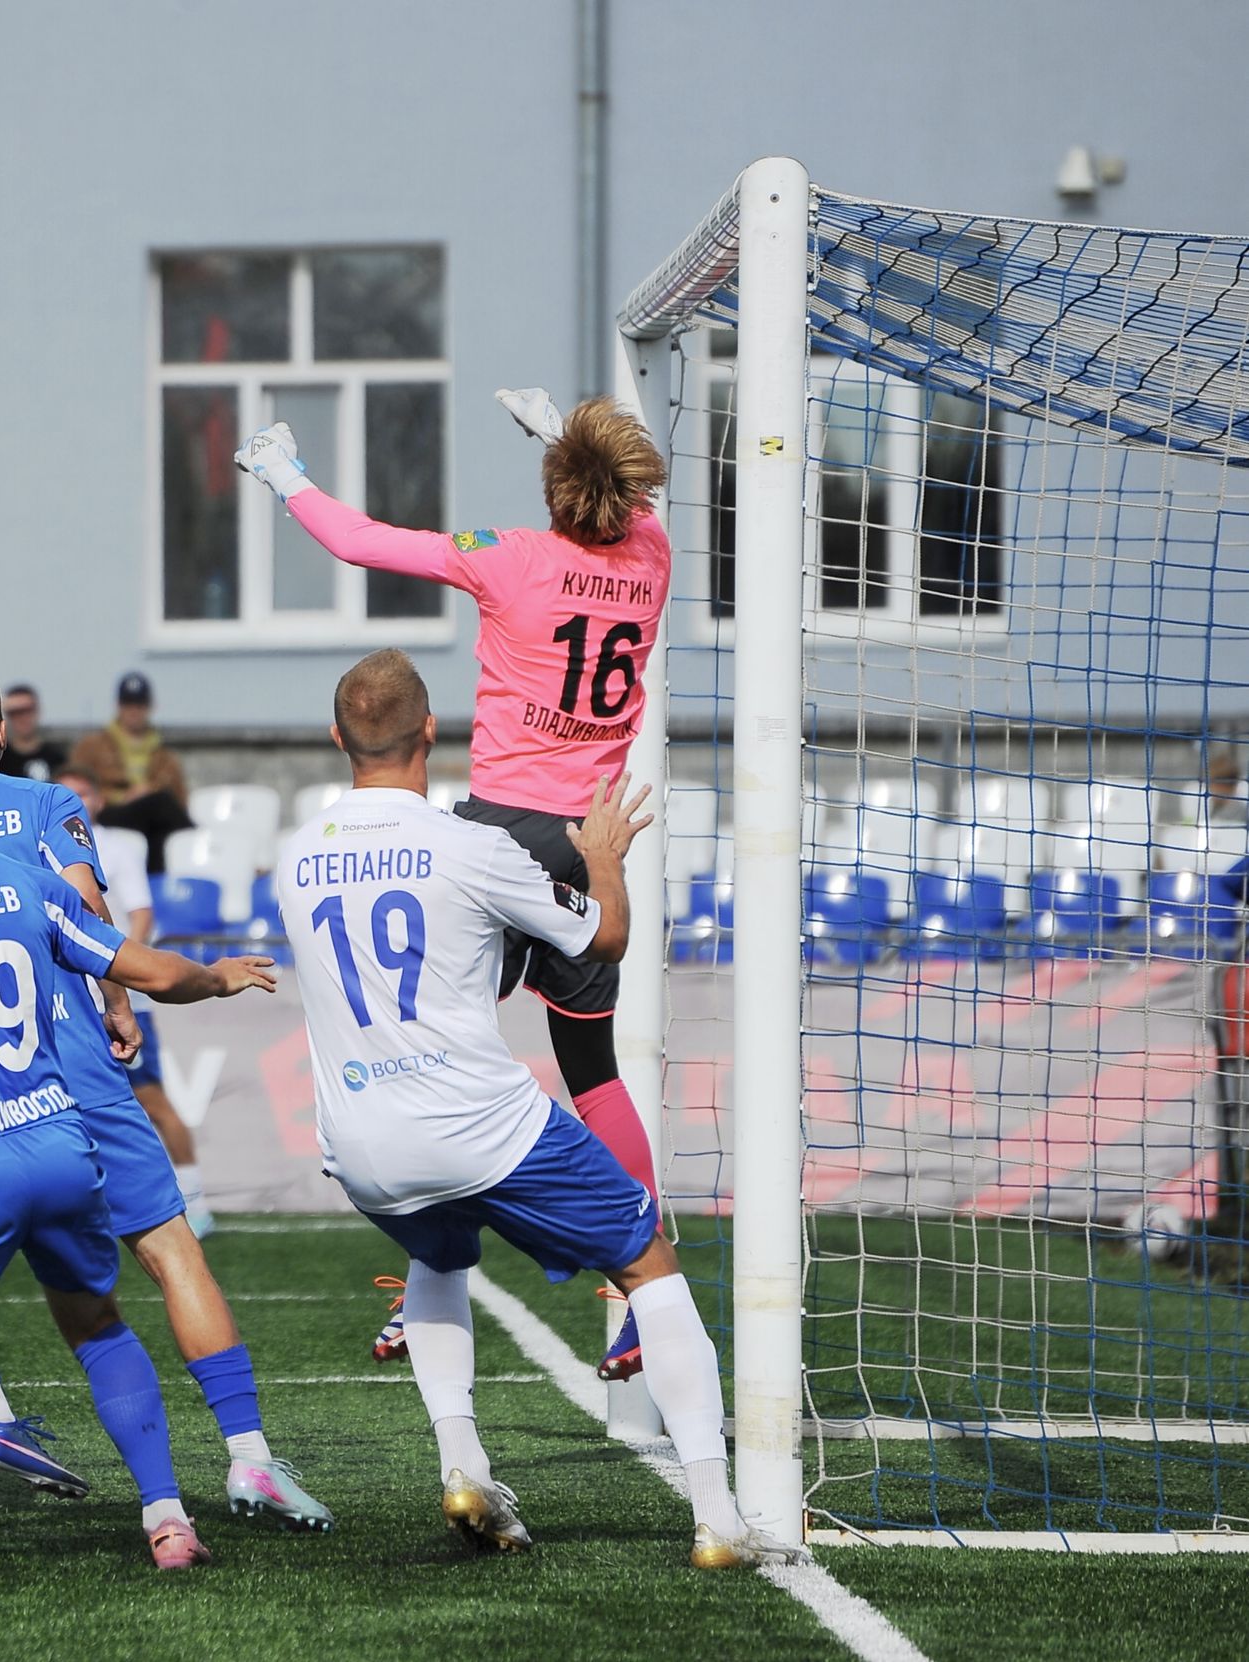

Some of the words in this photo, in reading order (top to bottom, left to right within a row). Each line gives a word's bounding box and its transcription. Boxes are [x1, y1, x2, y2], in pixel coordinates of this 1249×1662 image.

[561, 571, 653, 605] КУЛАГИН
[552, 614, 643, 718] 16
[296, 848, 433, 888] СТЕПАНОВ
[311, 889, 426, 1029] 19
[371, 1050, 450, 1079] ВОСТОК
